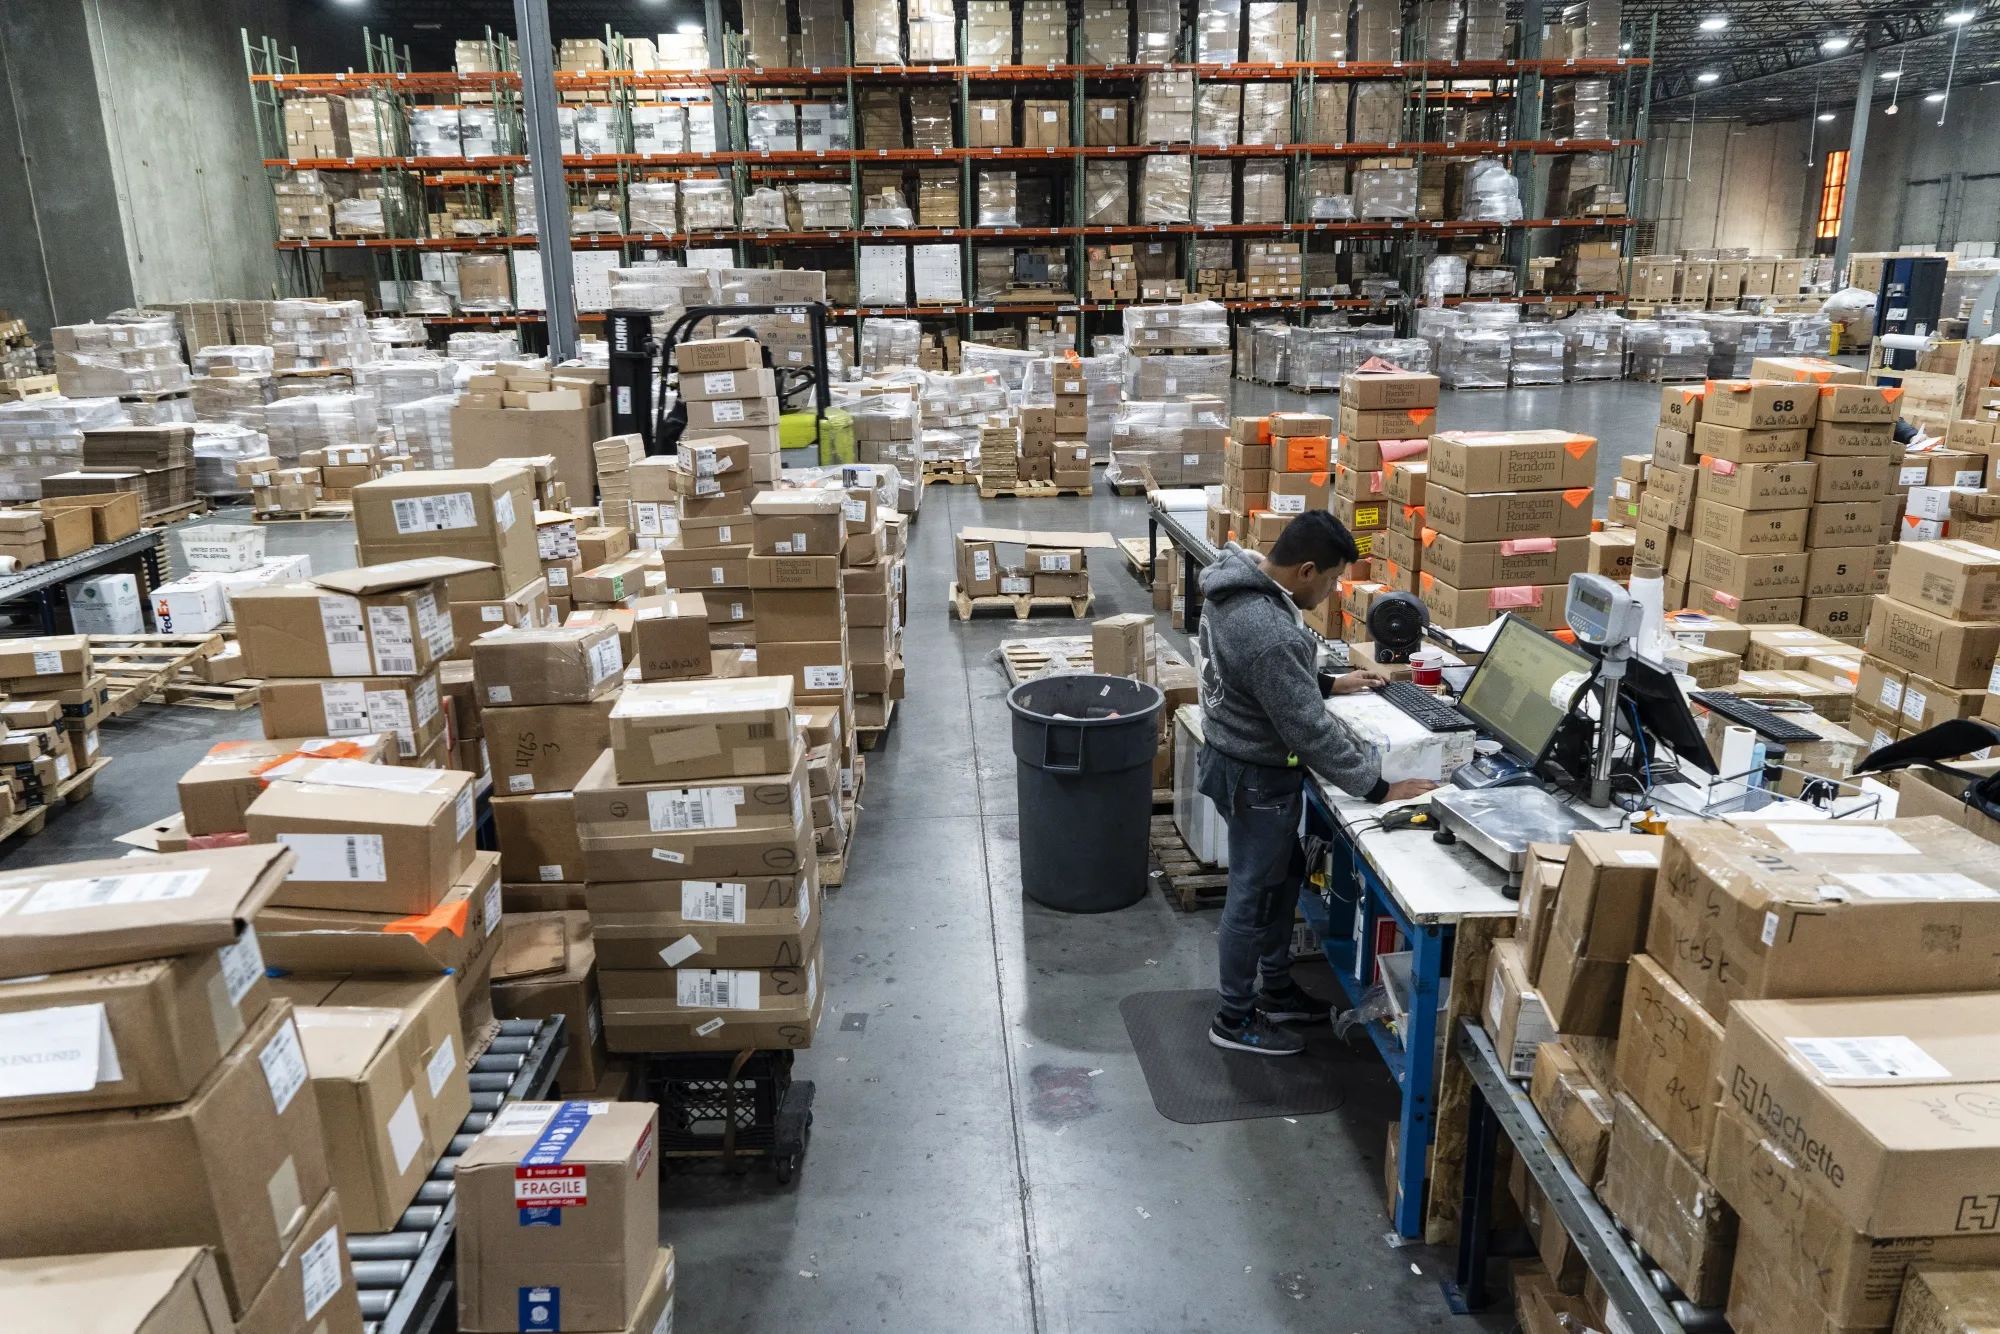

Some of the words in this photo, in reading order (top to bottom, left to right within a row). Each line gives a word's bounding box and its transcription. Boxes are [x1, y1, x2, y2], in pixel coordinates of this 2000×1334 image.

[615, 317, 628, 350] CLARK
[1386, 384, 1415, 392] Penguin
[1670, 403, 1681, 414] 68
[1773, 400, 1794, 412] 68
[1382, 426, 1406, 434] House
[1665, 440, 1672, 448] 18
[1508, 450, 1556, 460] Penguin
[1508, 461, 1555, 472] Random
[1507, 473, 1542, 484] House
[1508, 500, 1554, 510] Penguin
[1507, 510, 1553, 520] Random
[1506, 522, 1540, 532] House
[1645, 538, 1655, 550] 68
[776, 560, 811, 568] Penguin
[1502, 558, 1548, 568] Random
[1616, 557, 1633, 566] 68
[1501, 570, 1535, 580] House
[1836, 564, 1847, 575] 5
[158, 600, 173, 634] FedEx
[1829, 611, 1848, 621] 68
[1892, 613, 1933, 638] Penguin
[1890, 626, 1930, 652] Random
[1888, 640, 1919, 661] House
[11, 1049, 81, 1066] ENCLOSED
[1760, 1082, 1844, 1188] hachette
[522, 1182, 580, 1194] FRAGILE
